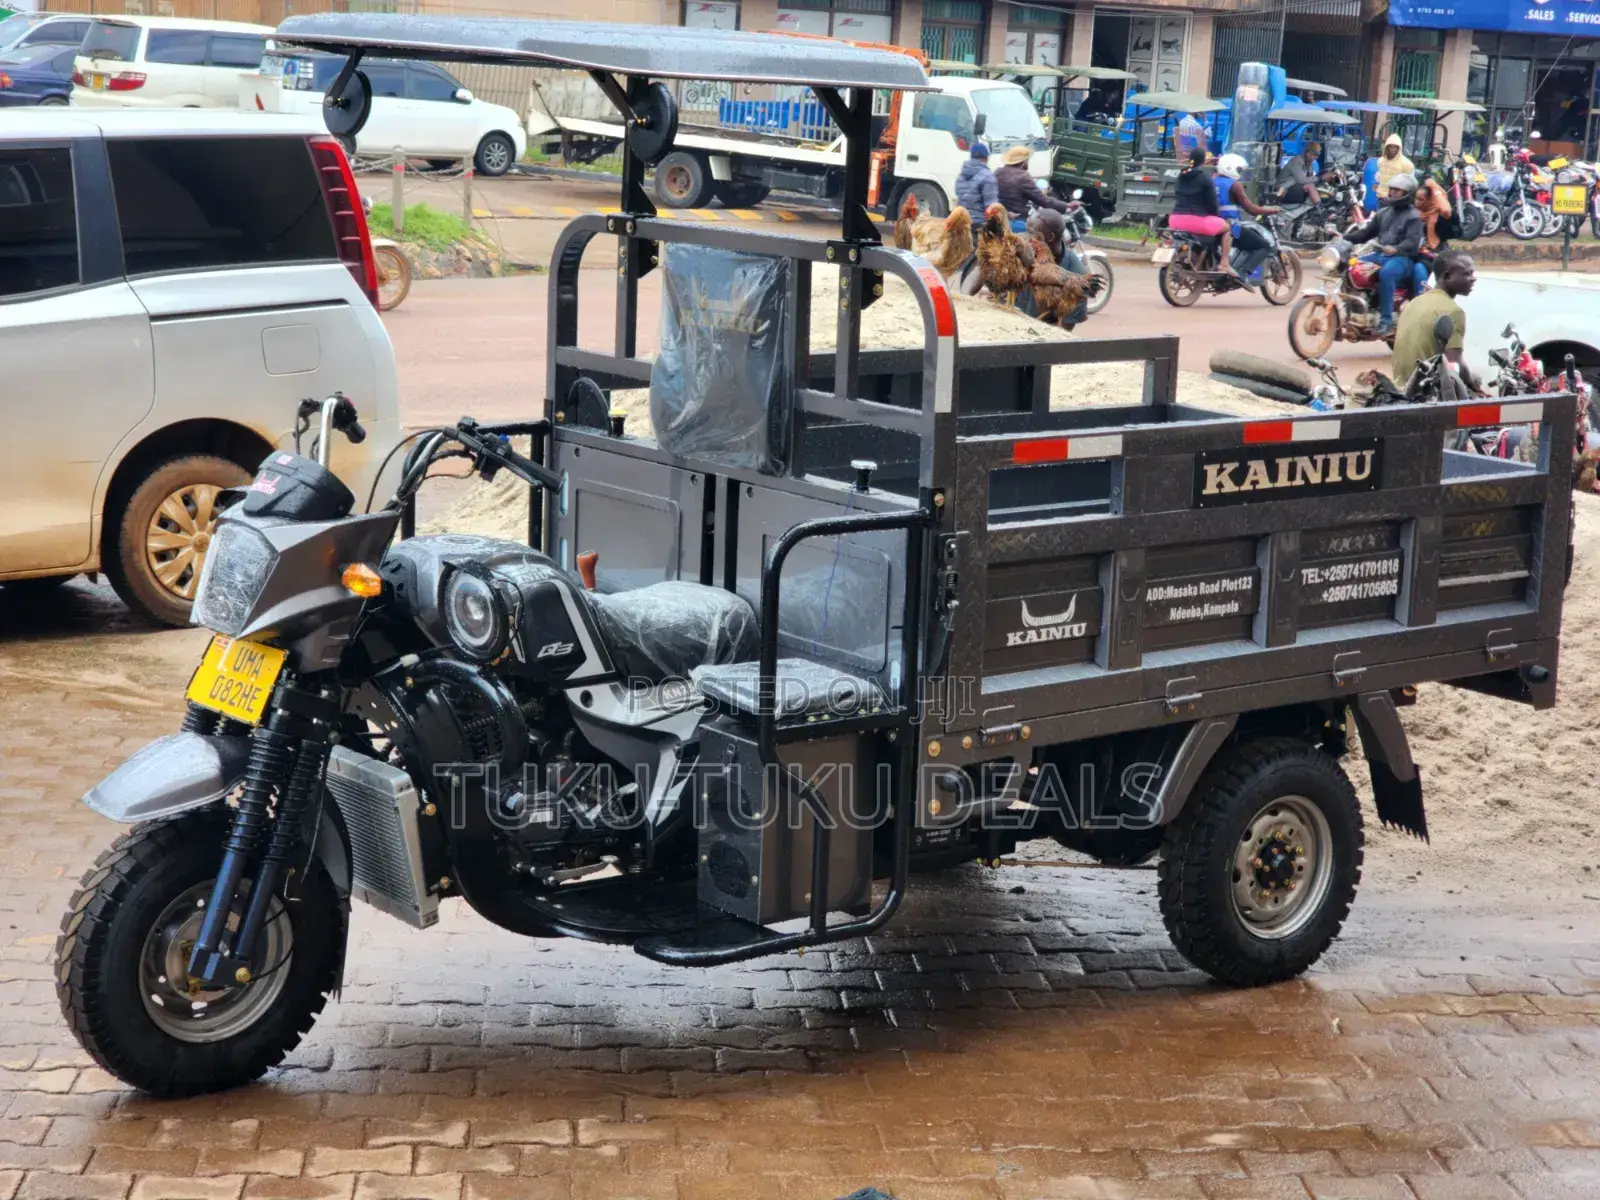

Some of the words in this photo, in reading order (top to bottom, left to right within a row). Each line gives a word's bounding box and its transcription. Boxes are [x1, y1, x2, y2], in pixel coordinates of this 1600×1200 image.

[1555, 199, 1562, 208] NO
[1563, 199, 1584, 209] PARKING
[1202, 449, 1376, 495] KAINIU
[1199, 580, 1220, 595] Road
[1006, 622, 1087, 647] KAINIU
[233, 646, 266, 678] UMA
